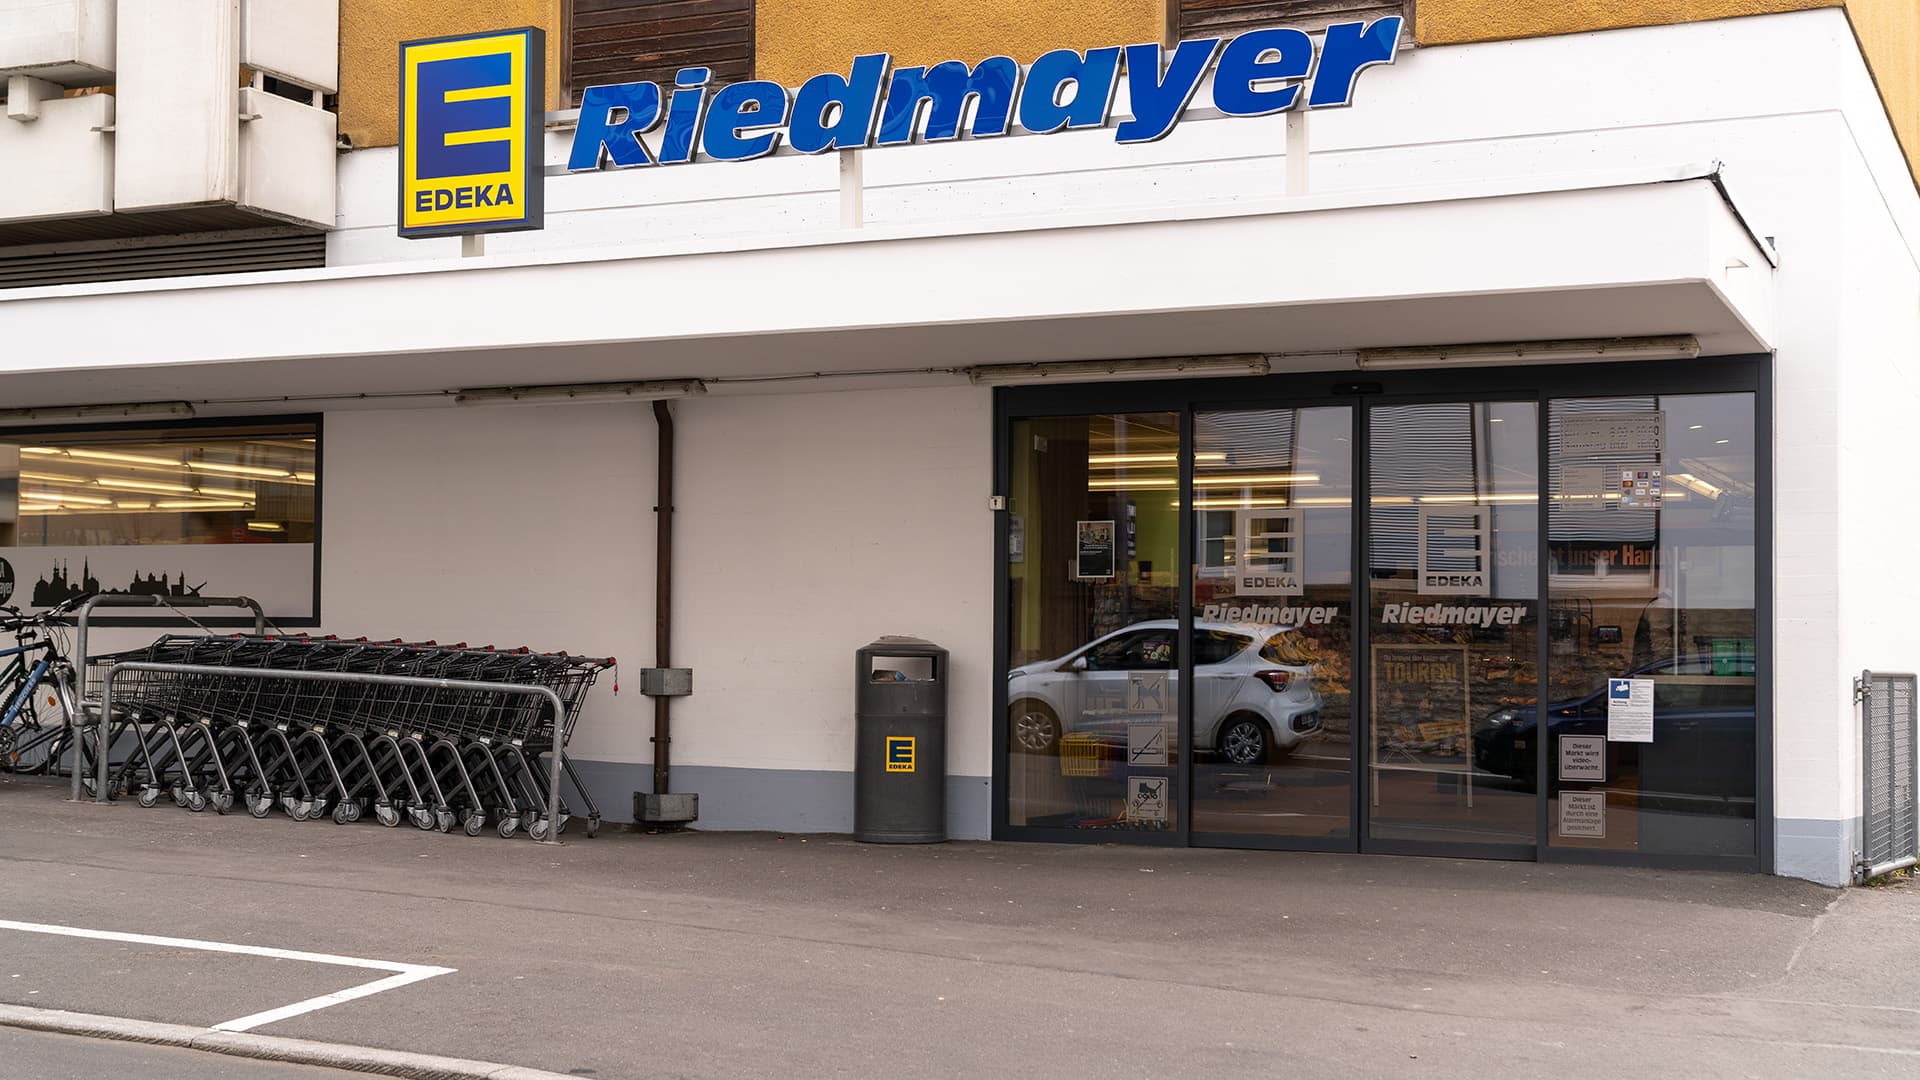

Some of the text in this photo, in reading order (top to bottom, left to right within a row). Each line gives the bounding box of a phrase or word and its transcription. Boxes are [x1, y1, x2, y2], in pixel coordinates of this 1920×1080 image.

[567, 15, 1404, 172] Riedmayer
[415, 183, 514, 213] EDEKA
[1243, 577, 1297, 588] EDEKA
[1426, 576, 1483, 587] EDEKA
[1201, 602, 1339, 627] Riedmayer
[1381, 602, 1528, 628] Riedmayer
